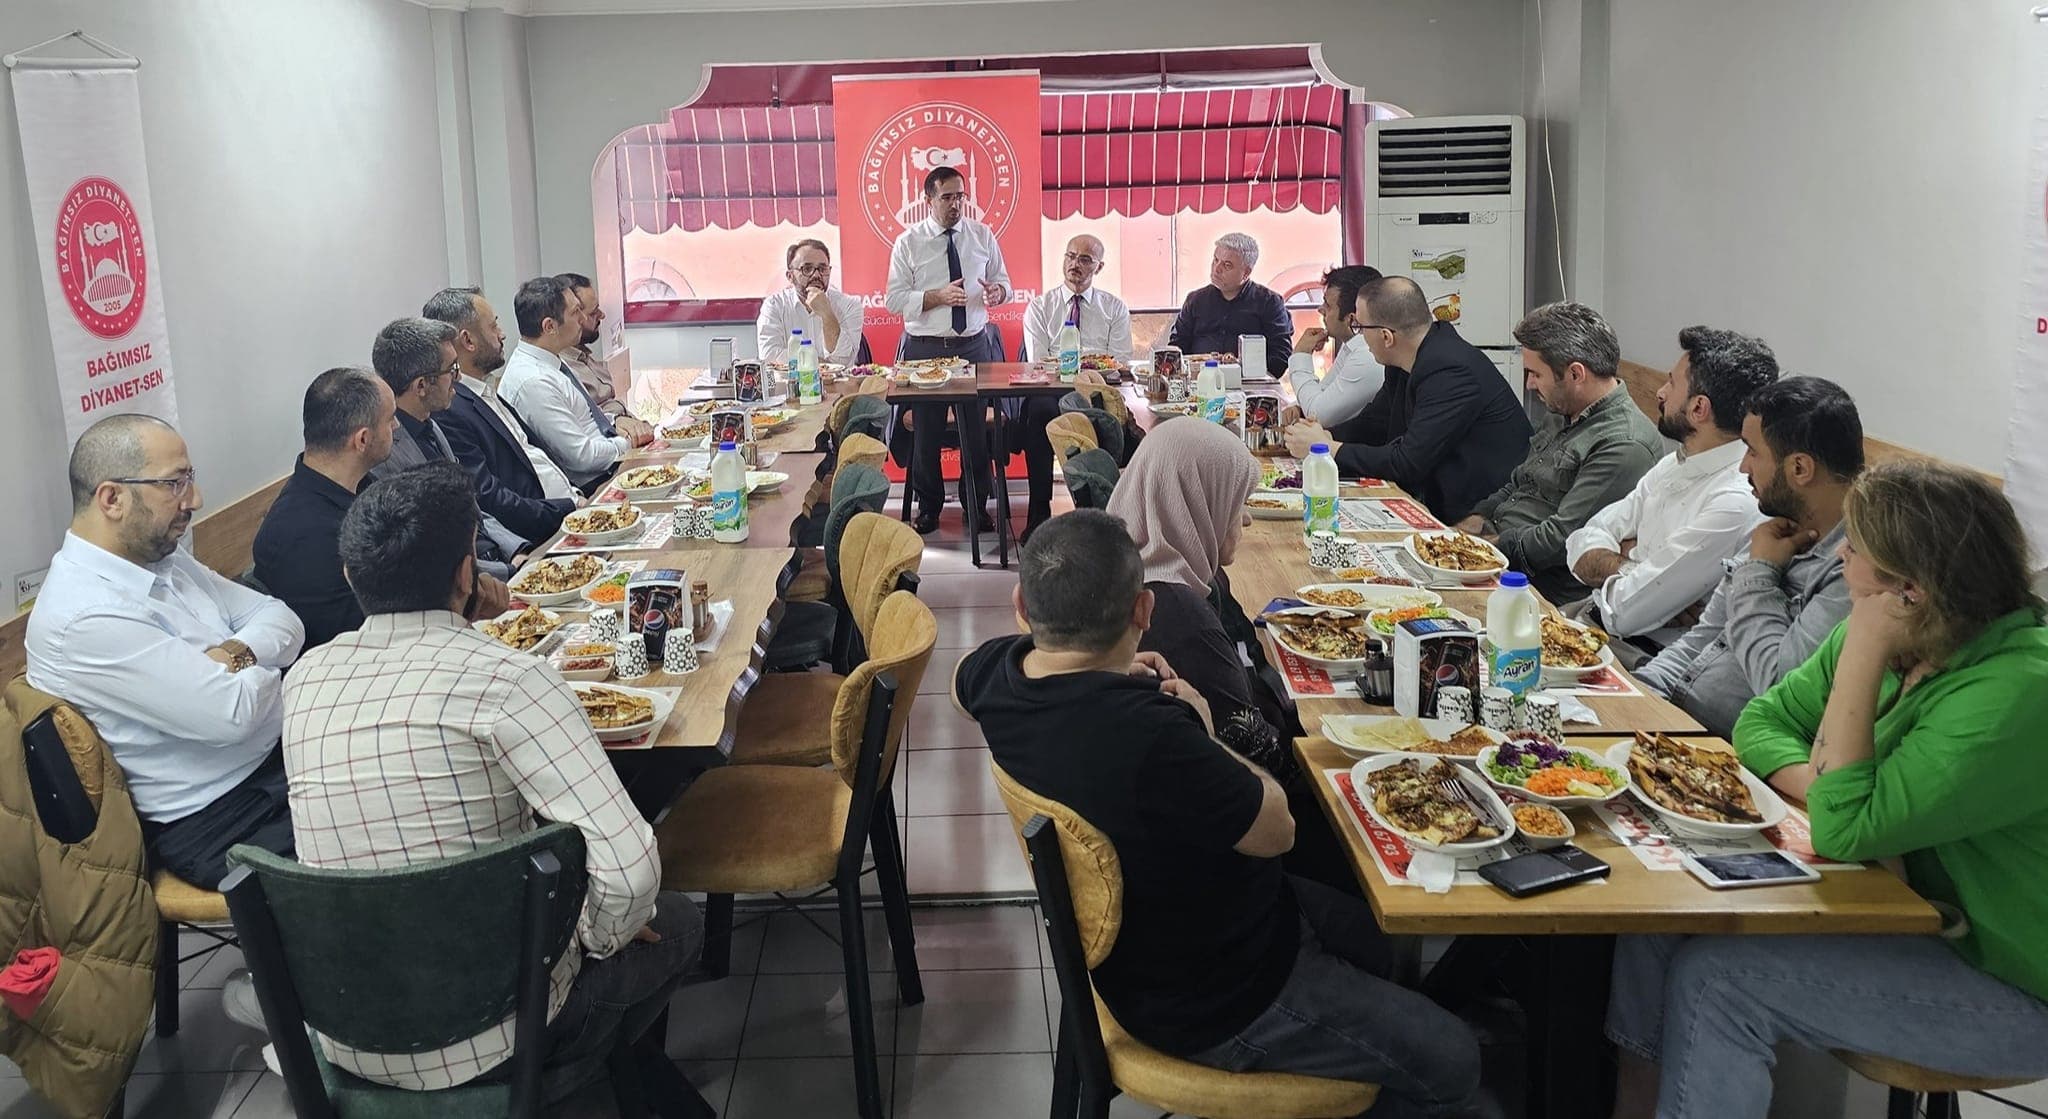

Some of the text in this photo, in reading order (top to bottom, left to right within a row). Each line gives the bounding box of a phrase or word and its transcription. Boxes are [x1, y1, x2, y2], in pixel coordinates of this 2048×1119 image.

[867, 108, 1010, 194] BAĞIMSIZ DİYANET-SEN
[58, 182, 143, 273] BAĞIMSIZ DİYANET-SEN
[104, 300, 122, 312] 2005
[1010, 288, 1036, 305] EN
[86, 343, 152, 378] BAĞIMSIZ
[80, 368, 164, 413] DİYANET-SEN
[1503, 659, 1536, 679] Ayran
